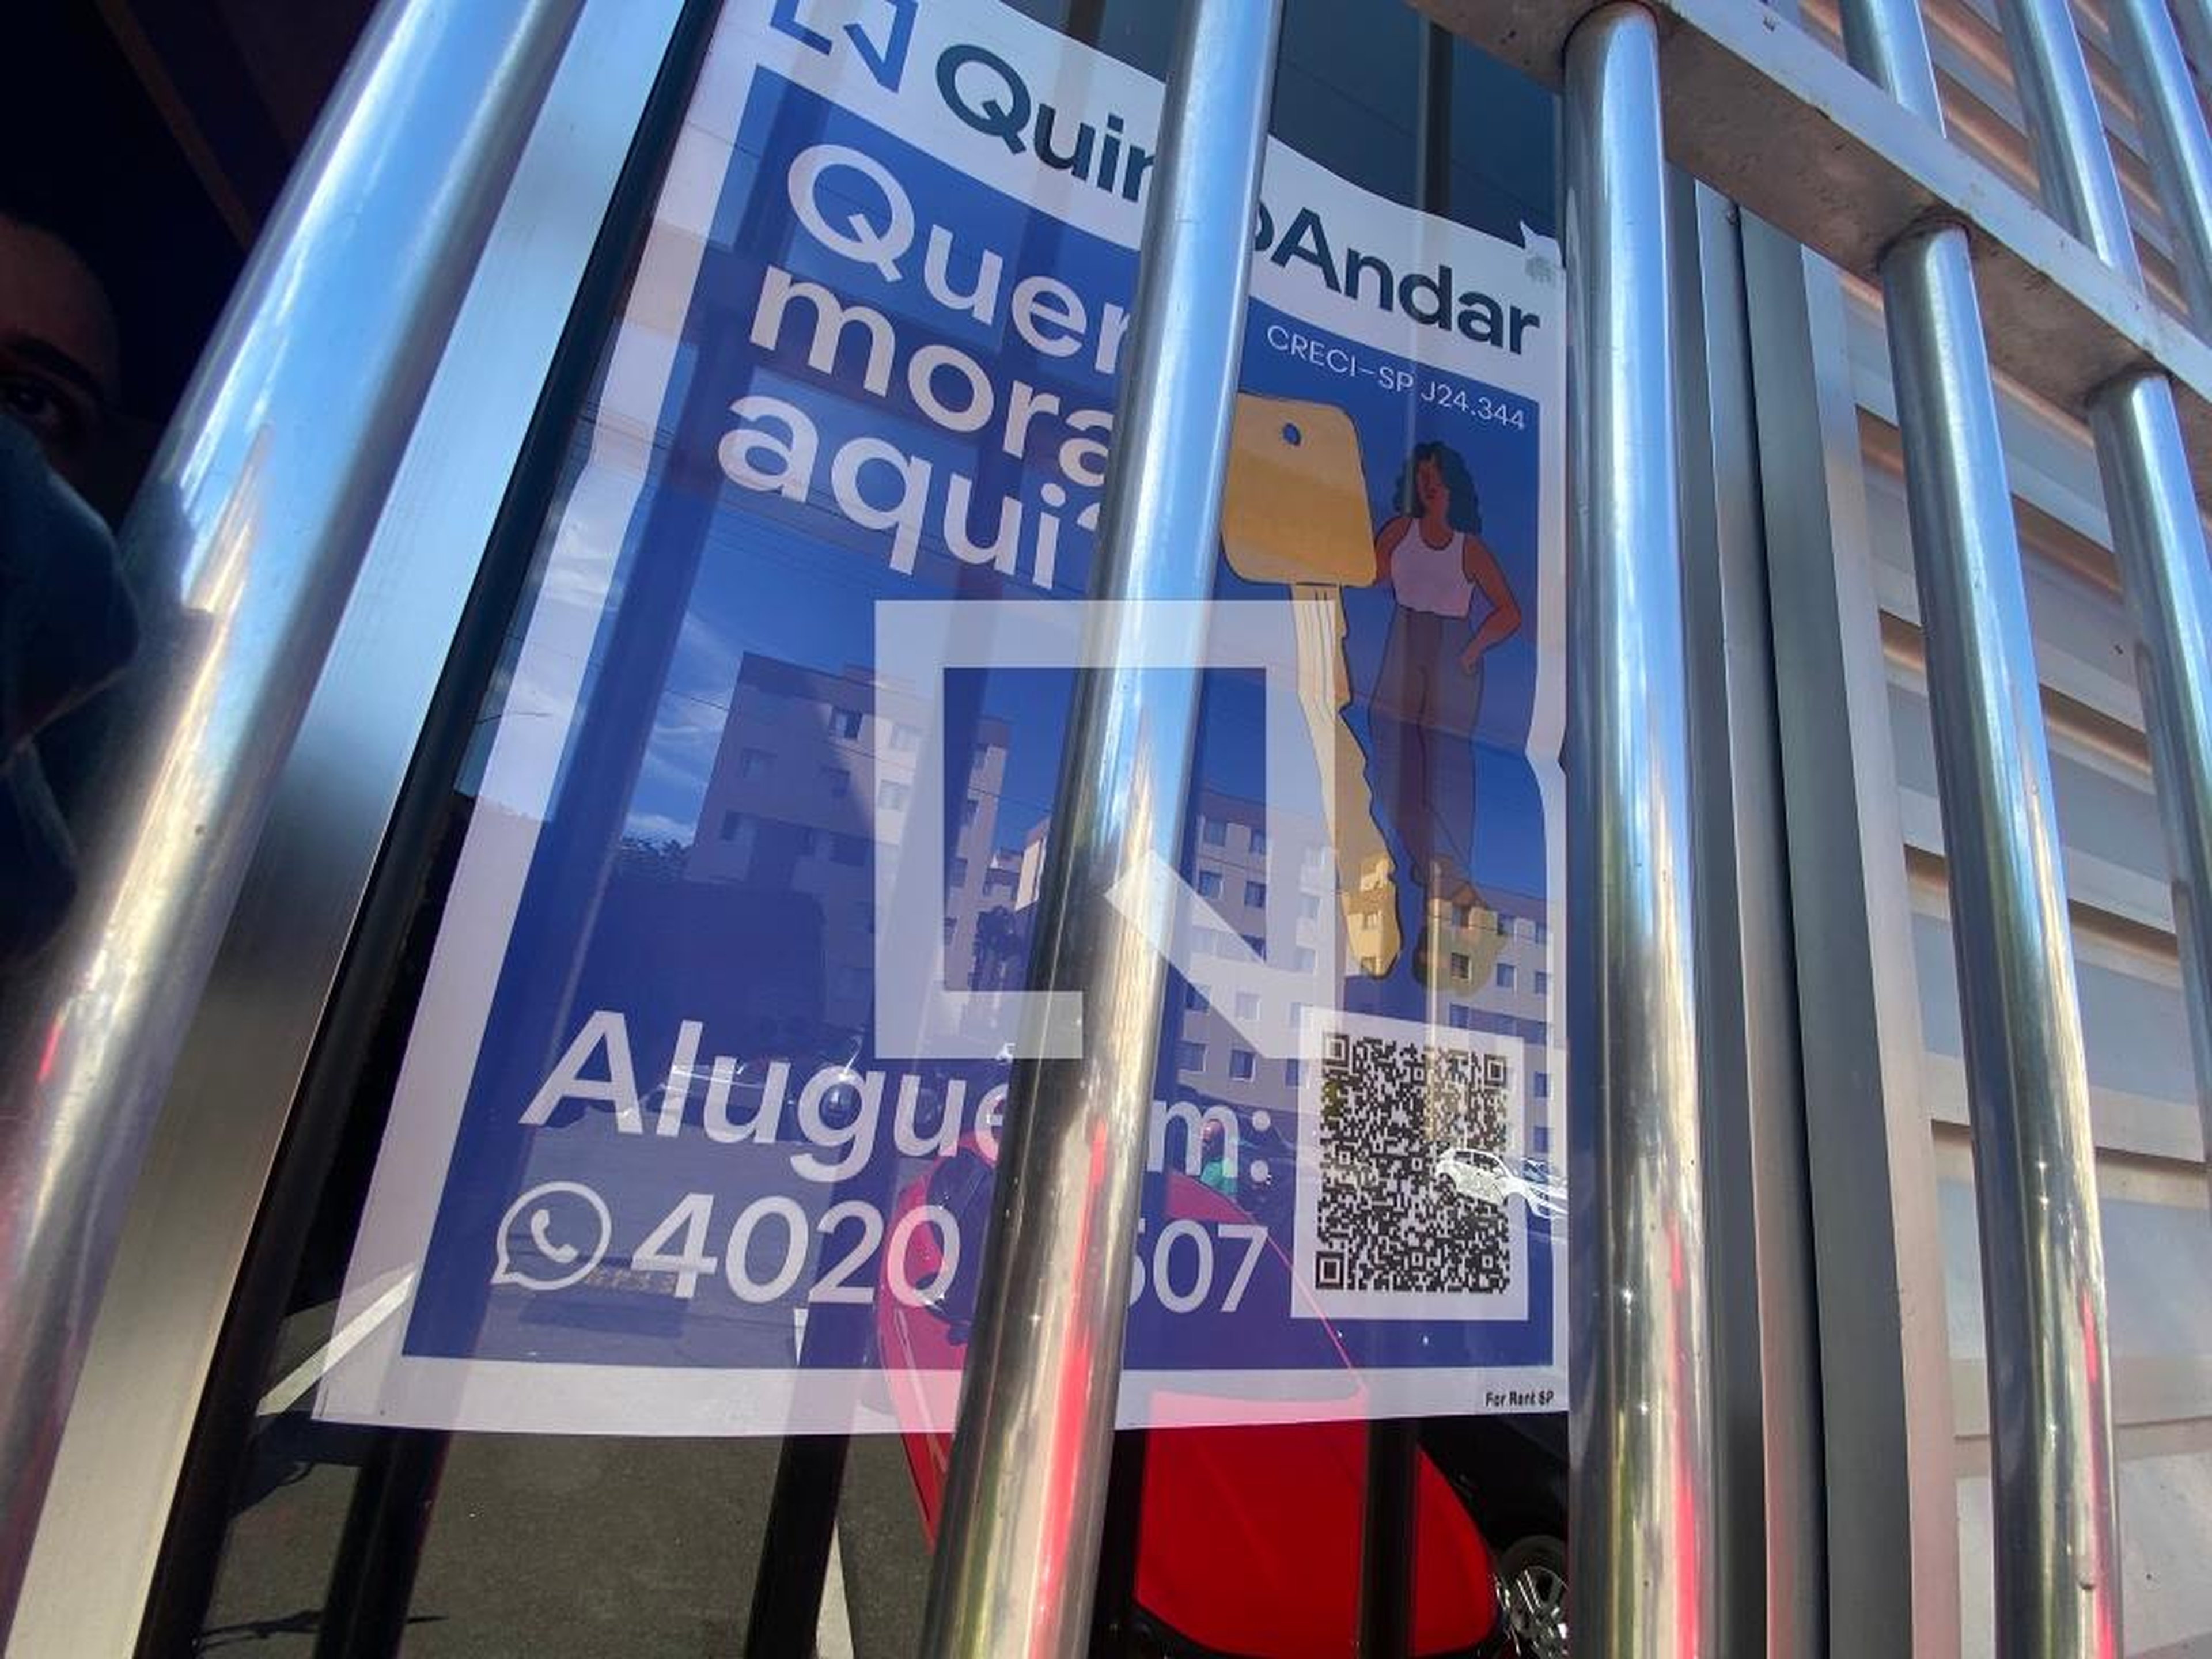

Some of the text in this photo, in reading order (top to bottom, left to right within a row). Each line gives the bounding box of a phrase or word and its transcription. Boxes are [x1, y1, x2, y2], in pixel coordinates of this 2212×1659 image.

[934, 41, 1540, 356] QuiAndar
[748, 265, 1115, 487] mora
[1420, 381, 1525, 431] J24.344
[717, 394, 1100, 590] aqui
[630, 1192, 961, 1309] 4020
[1485, 1391, 1506, 1407] For
[1538, 1389, 1555, 1406] SP
